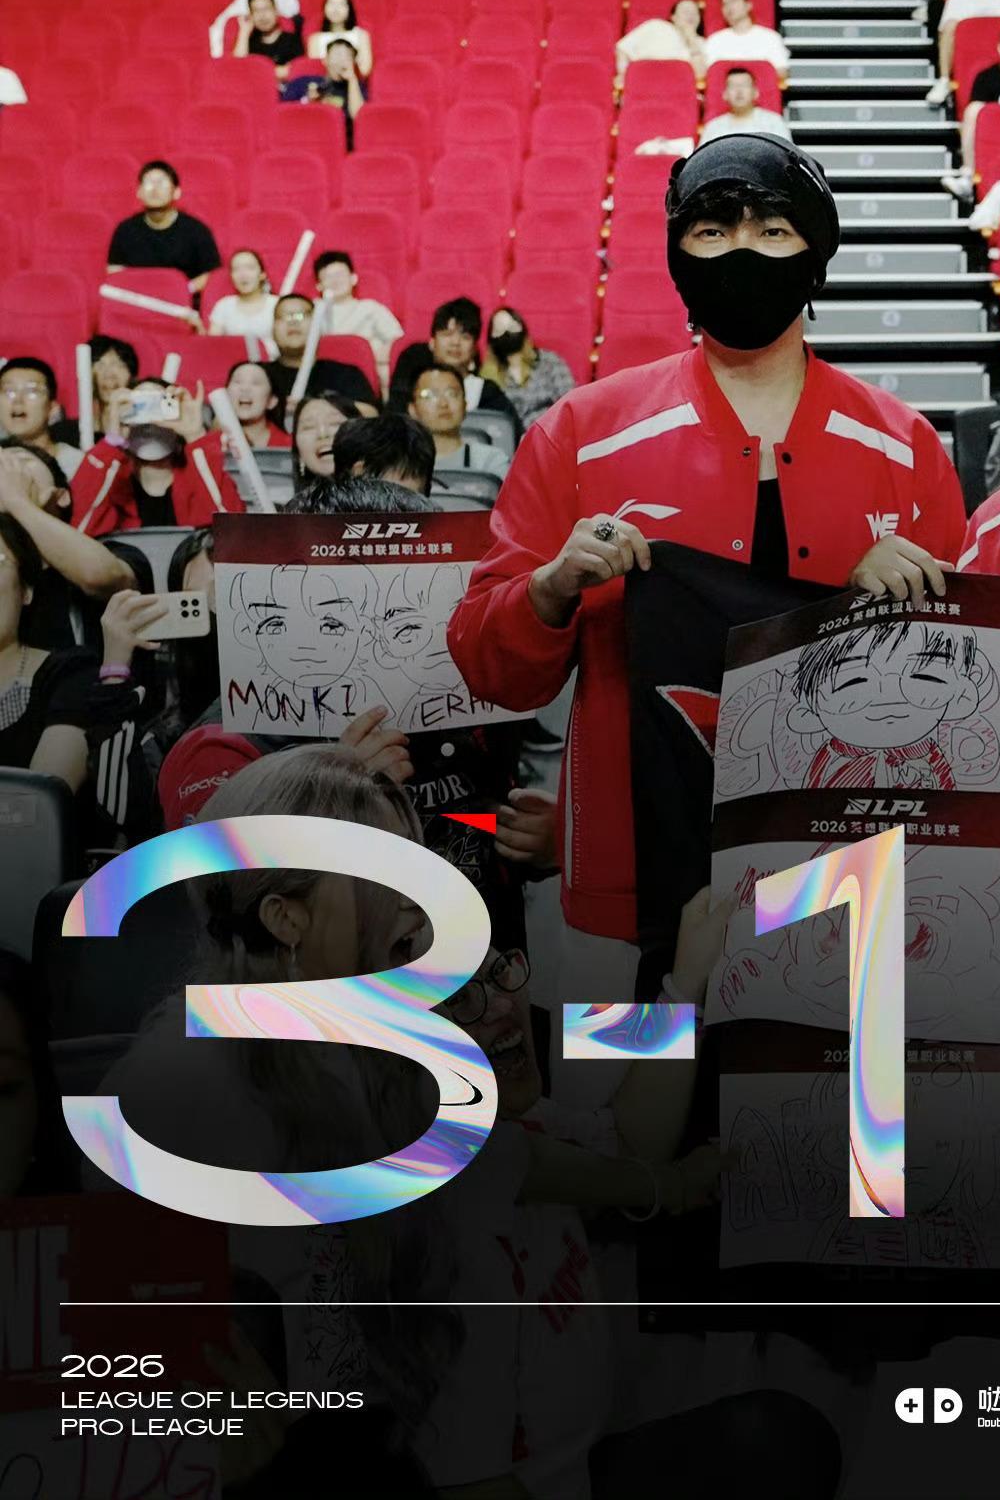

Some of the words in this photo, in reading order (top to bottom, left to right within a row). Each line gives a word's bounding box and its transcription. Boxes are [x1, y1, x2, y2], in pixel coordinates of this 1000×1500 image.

[367, 523, 423, 539] LPL
[865, 510, 900, 542] WE
[310, 543, 346, 557] 2026
[348, 541, 453, 557] 英雄联盟职业联赛
[817, 615, 850, 634] 2026
[227, 678, 357, 723] MONKI
[870, 798, 929, 817] LPL
[809, 820, 847, 834] 2026
[823, 1050, 850, 1064] 202
